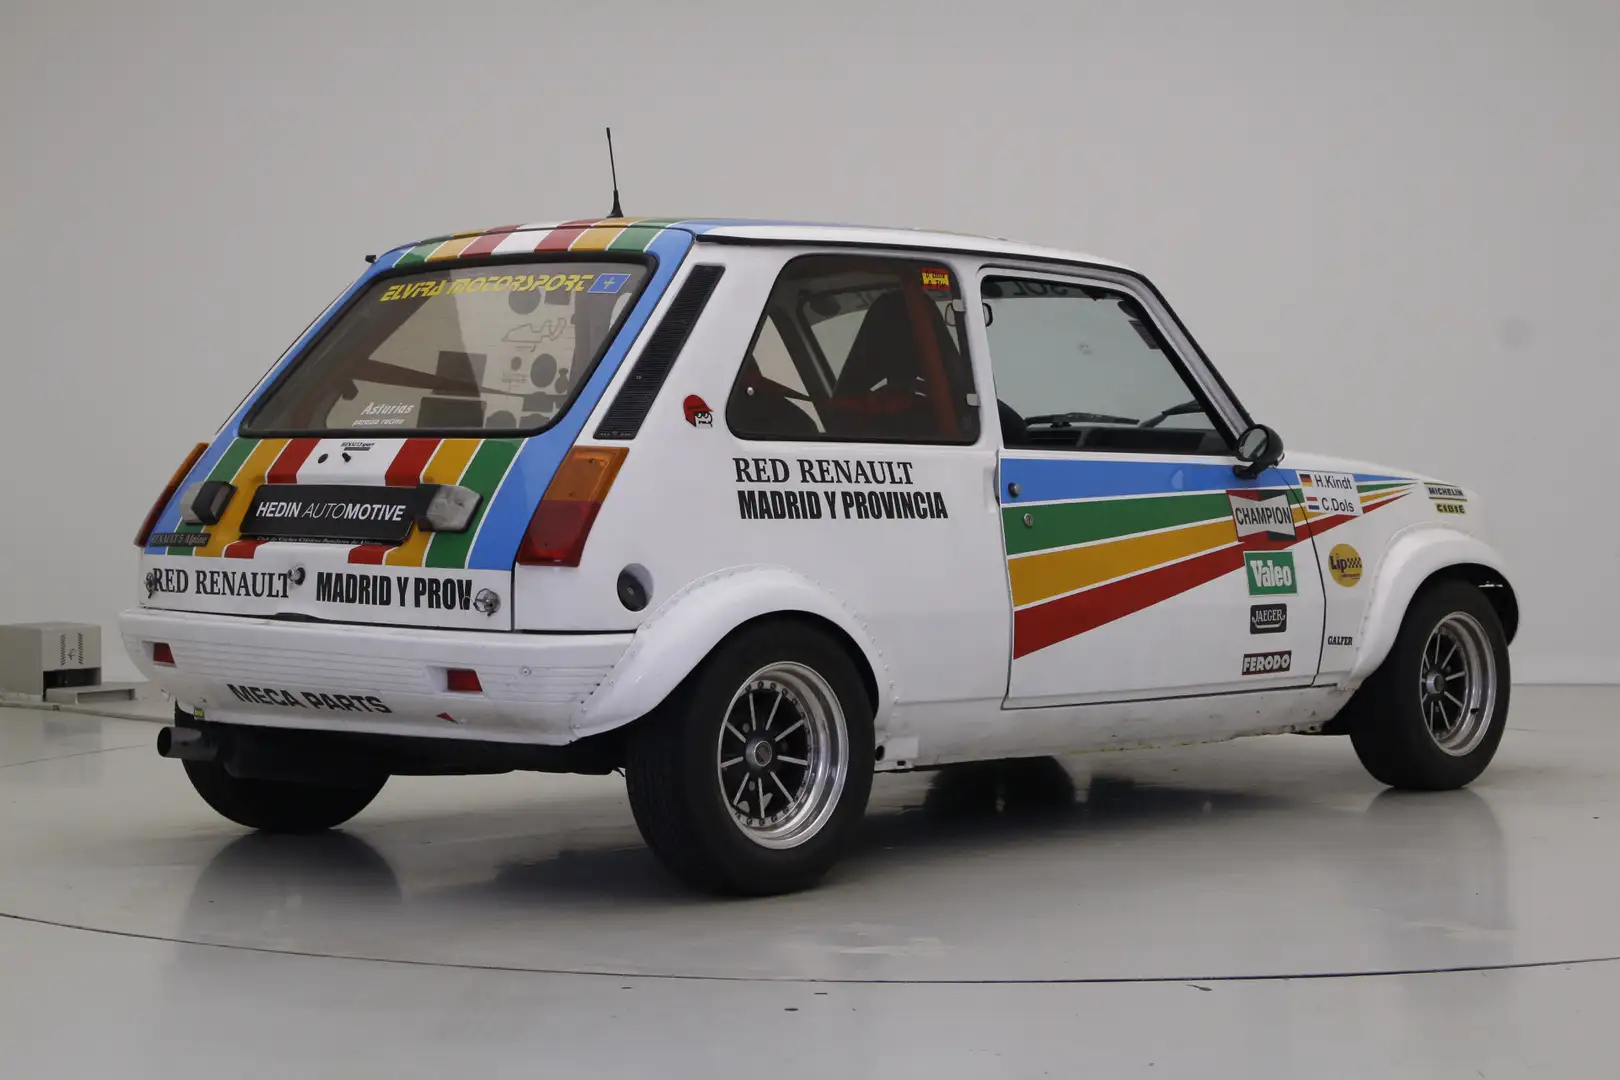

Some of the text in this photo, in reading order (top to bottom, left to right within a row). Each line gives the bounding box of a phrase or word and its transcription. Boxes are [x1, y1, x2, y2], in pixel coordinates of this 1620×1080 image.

[380, 274, 595, 301] ELVIRA MOTORSPORT
[360, 401, 415, 415] Asturias
[732, 457, 913, 485] RED RENAULT
[1314, 474, 1352, 490] H.Kindt
[1428, 487, 1464, 497] MICHELIN
[255, 501, 407, 521] HEDIN AUTOMOTIVE
[737, 490, 949, 520] MADRID Y PROVINCIA
[1321, 497, 1354, 512] C.Dols
[1436, 503, 1465, 514] CIBIE
[1235, 505, 1292, 526] CHAMPION
[1329, 553, 1347, 573] Lip
[1249, 559, 1292, 588] Valeo
[152, 567, 473, 610] RED RENAULT MADRID Y PROV
[1252, 608, 1286, 623] JAEGER
[1327, 636, 1353, 646] GALFER
[1243, 654, 1290, 672] FERODO
[227, 684, 393, 714] MECA PARTS
